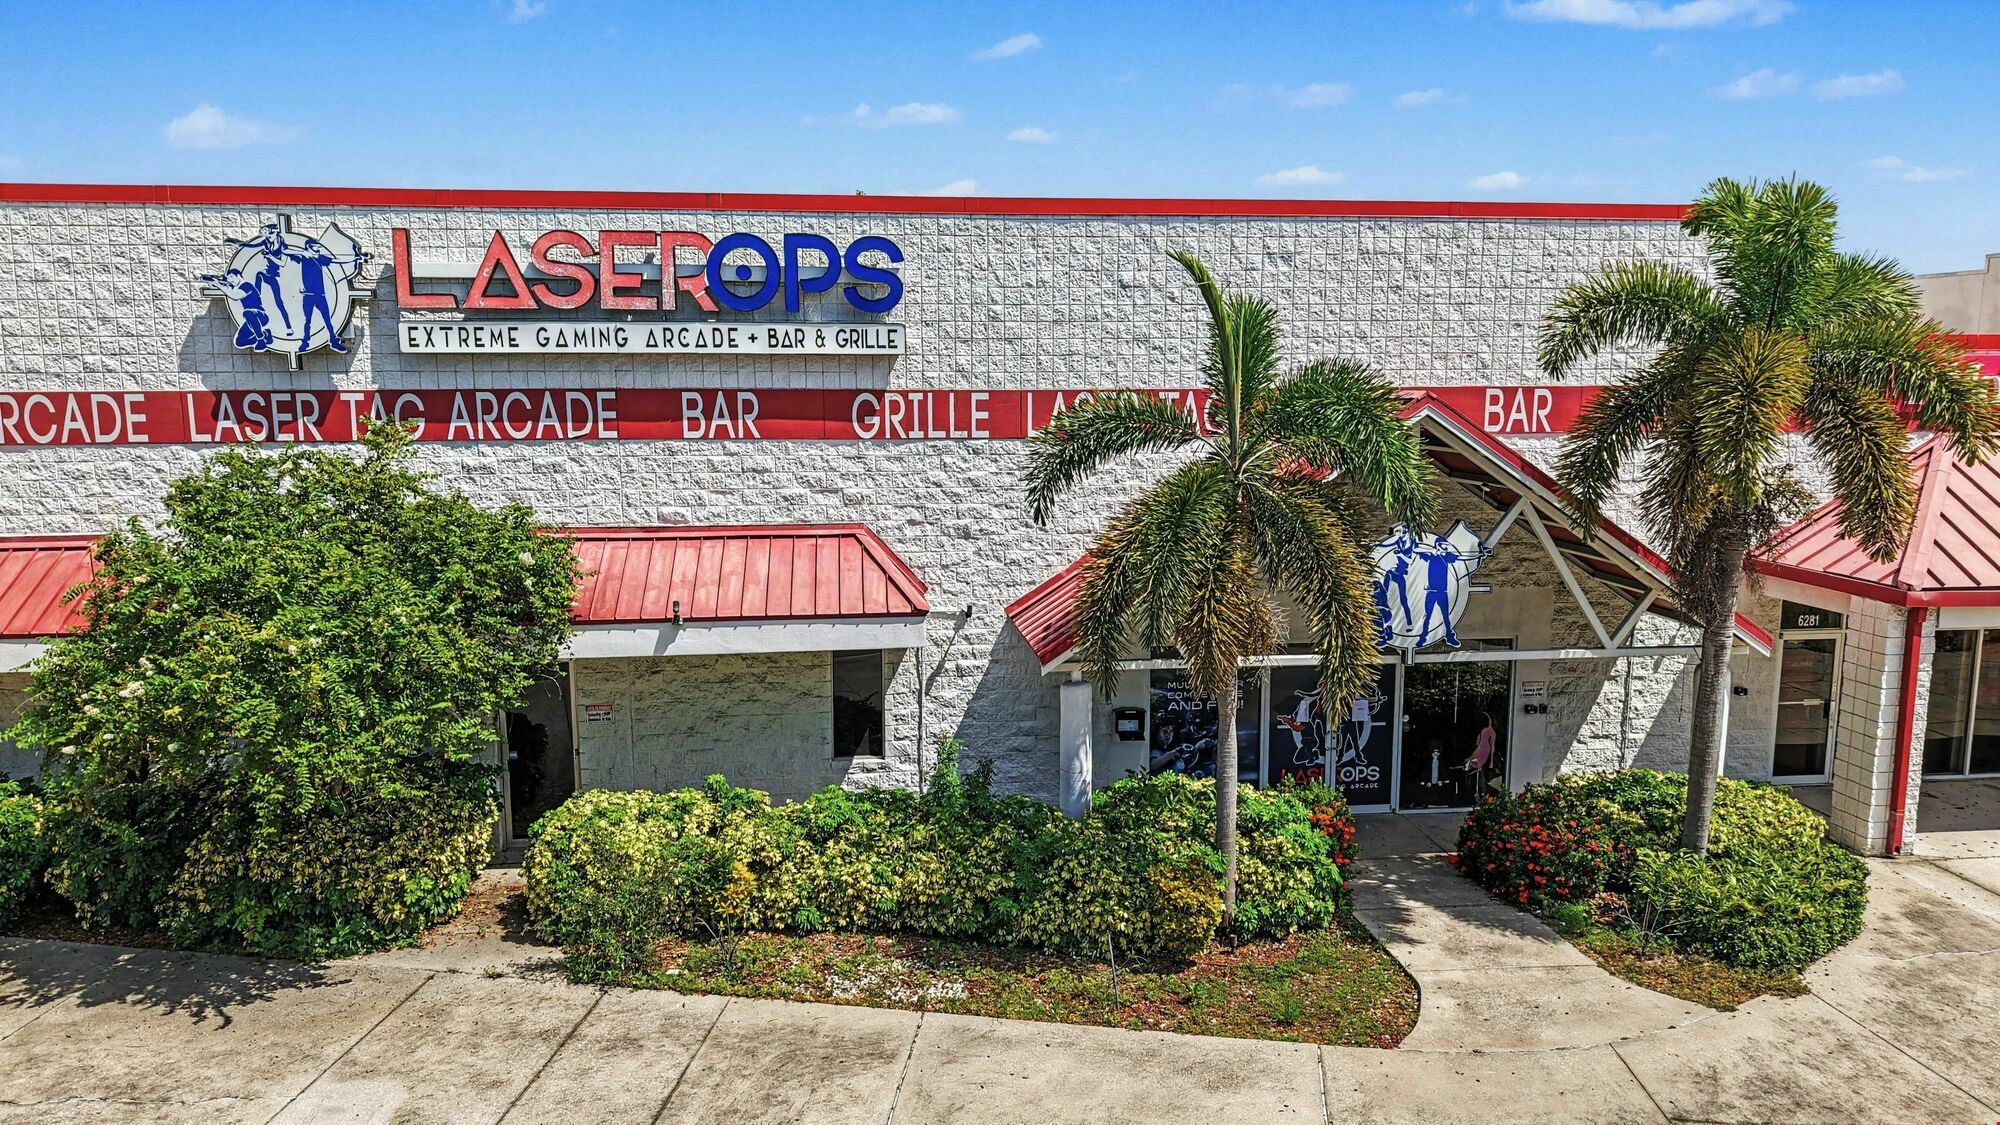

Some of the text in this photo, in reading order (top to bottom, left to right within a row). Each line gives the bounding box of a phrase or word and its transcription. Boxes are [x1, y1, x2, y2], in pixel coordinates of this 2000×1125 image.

[407, 326, 520, 348] EXTREME
[536, 326, 628, 348] GAMING
[646, 327, 739, 349] ARCADE
[768, 328, 805, 349] BAR
[815, 328, 826, 349] &
[836, 328, 898, 349] GRILLE
[186, 392, 324, 442] LASER
[448, 391, 618, 440] ARCADE
[681, 390, 762, 439] BAR
[852, 392, 990, 439] GRILLE
[1484, 388, 1552, 433] BAR
[1798, 614, 1820, 627] 6281
[1168, 701, 1202, 711] AND
